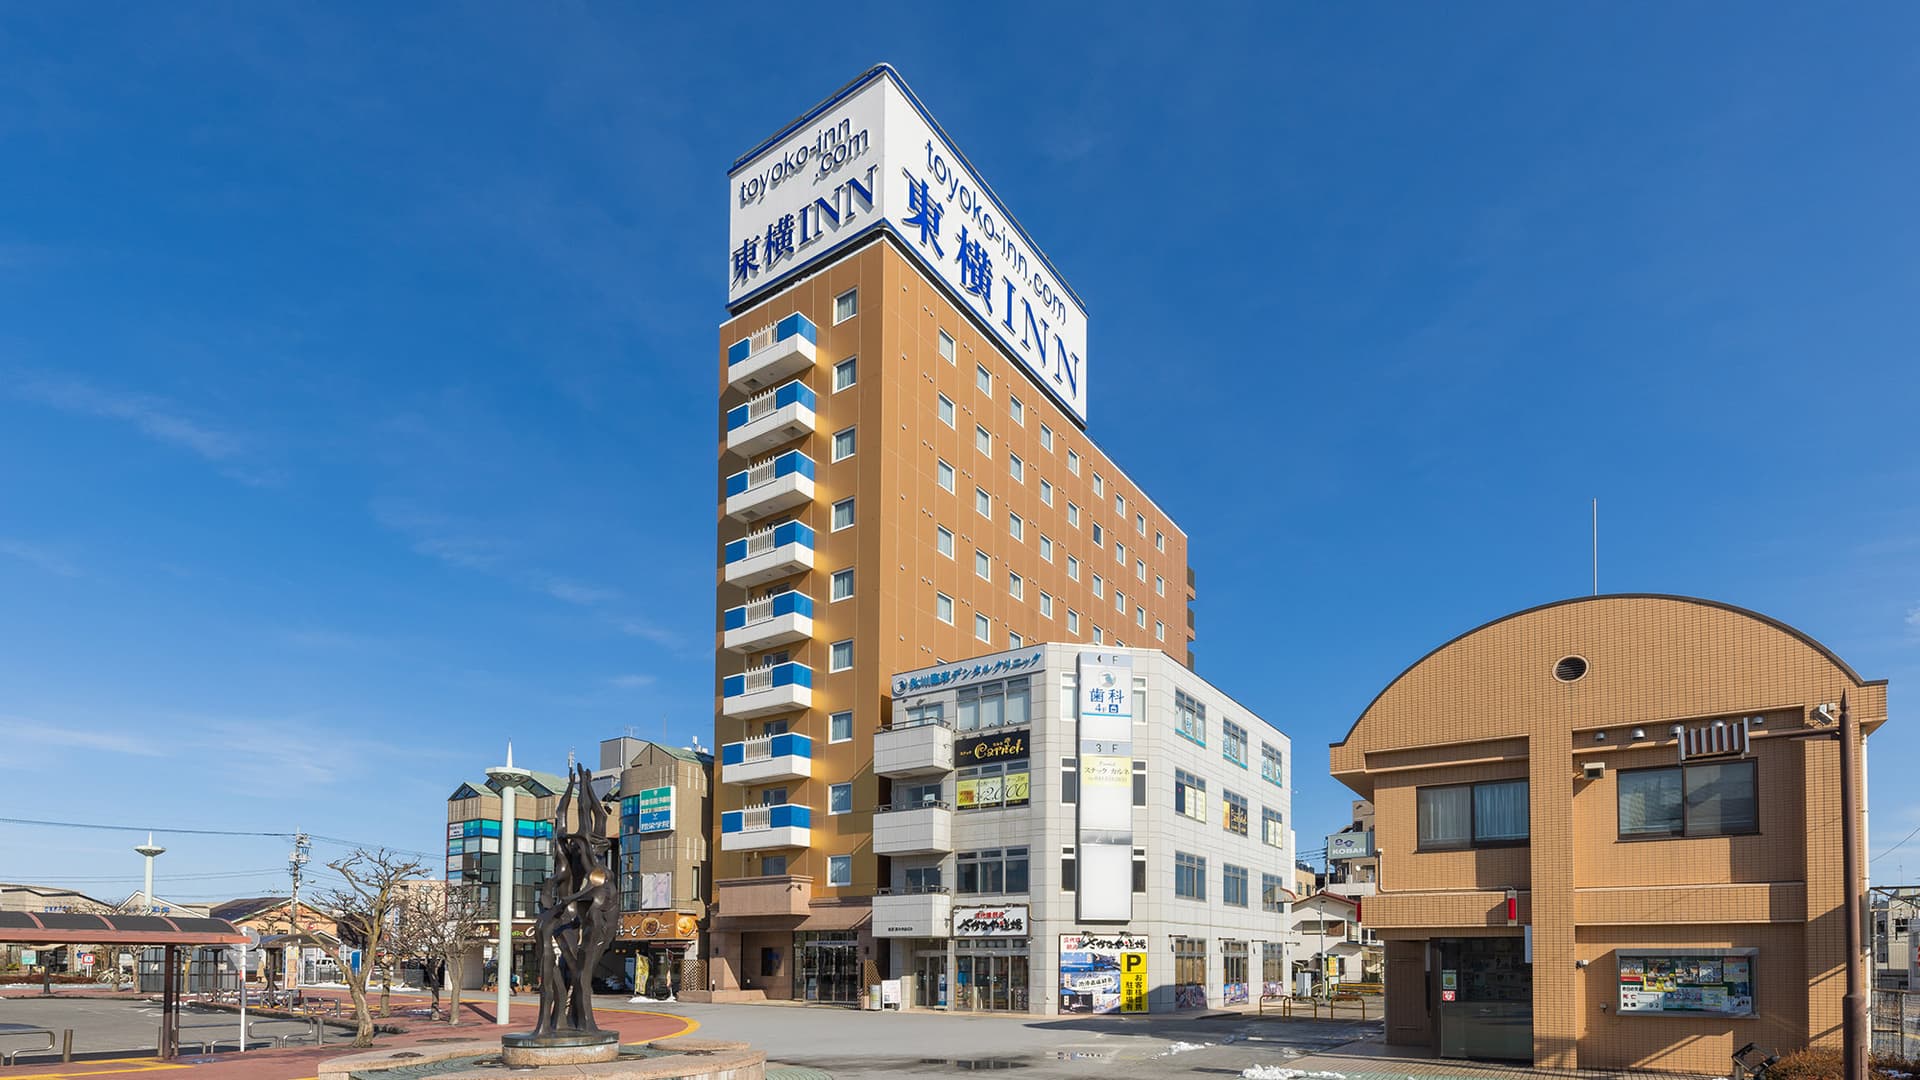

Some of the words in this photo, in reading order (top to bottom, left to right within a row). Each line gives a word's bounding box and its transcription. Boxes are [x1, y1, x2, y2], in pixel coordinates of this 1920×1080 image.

[740, 117, 851, 202] toyoko-inn
[815, 129, 868, 178] .com
[731, 163, 878, 288] 東横INN
[924, 139, 1067, 325] toyoko-inn.com
[901, 165, 1080, 401] 東横INN
[1090, 688, 1125, 704] 歯科
[1332, 847, 1366, 855] KOBAN
[1126, 954, 1142, 972] P
